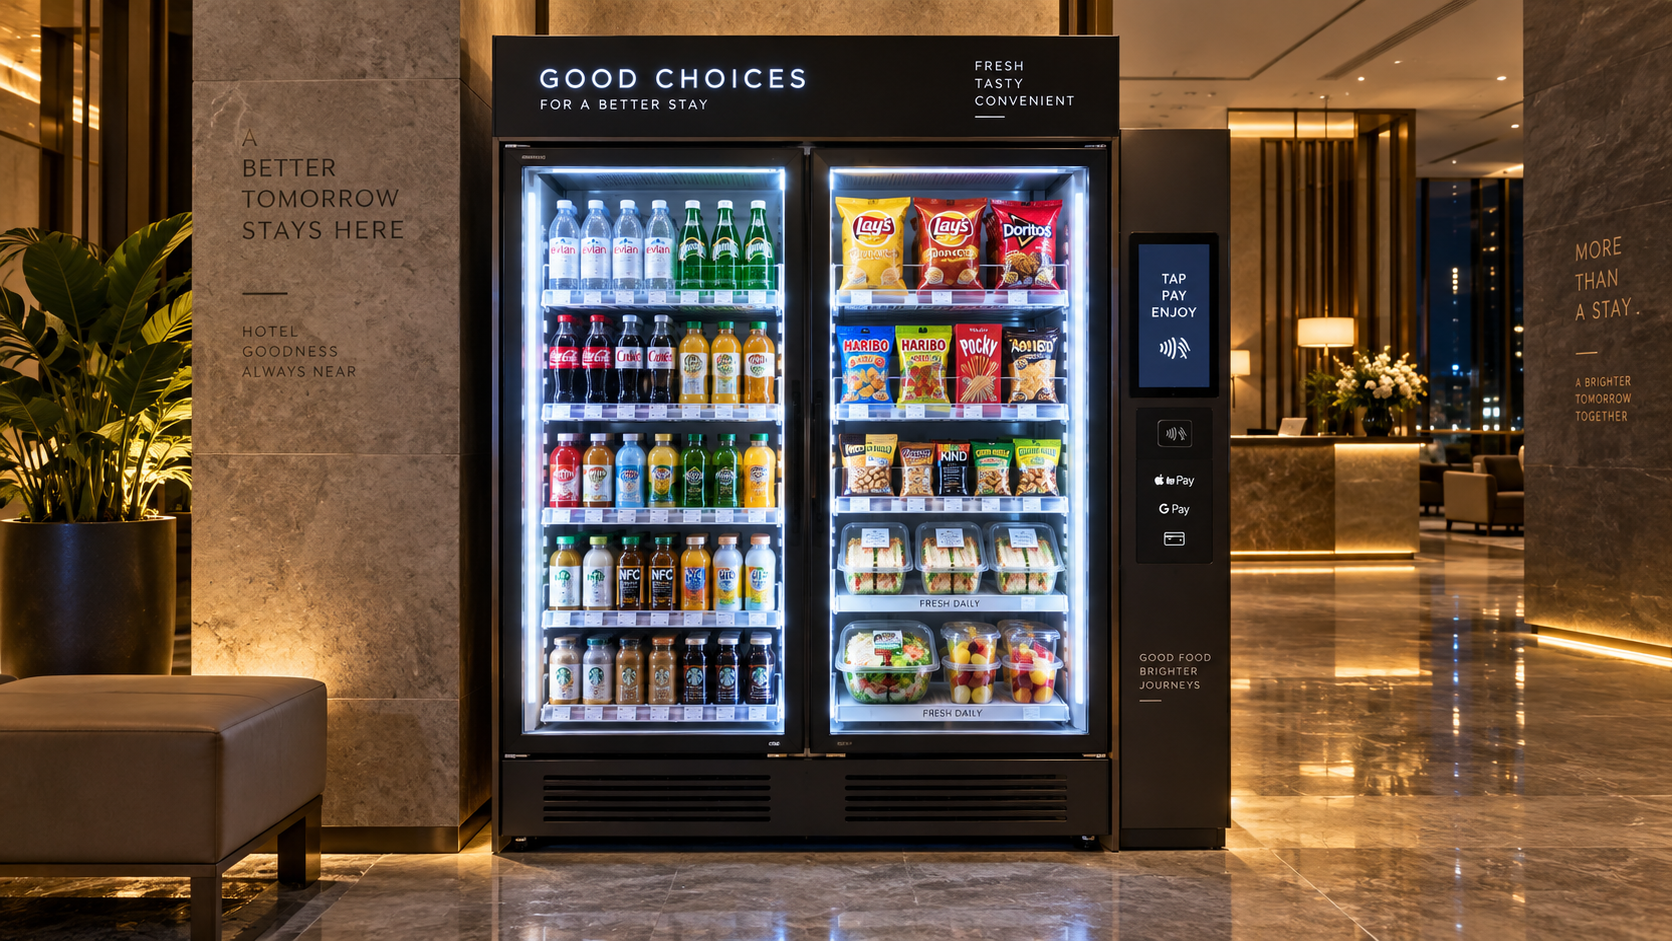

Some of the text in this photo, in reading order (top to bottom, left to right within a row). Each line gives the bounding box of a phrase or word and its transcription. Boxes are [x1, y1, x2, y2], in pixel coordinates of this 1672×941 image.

[975, 61, 1024, 71] FRESH
[540, 68, 806, 88] GOOD CHOICES
[975, 78, 1023, 89] TASTY
[541, 99, 708, 110] FOR A BETTER STAY
[975, 95, 1074, 106] CONVENIENT
[242, 129, 257, 146] A
[243, 158, 336, 177] BETTER
[242, 189, 399, 208] TOMORROW
[242, 220, 404, 240] STAYS HERE
[856, 216, 893, 236] Lay's
[933, 216, 971, 236] Lay's
[1003, 223, 1052, 238] Doritos
[1576, 236, 1622, 261] MORE
[1162, 274, 1187, 284] TAP
[1575, 268, 1618, 291] THAN
[1162, 291, 1187, 301] PAY
[1151, 307, 1197, 318] ENJOY
[1575, 303, 1586, 321] A
[242, 326, 299, 337] HOTEL
[843, 339, 889, 352] HARIBO
[901, 339, 946, 352] HARIBO
[243, 346, 338, 357] GOODNESS
[242, 366, 356, 377] ALWAYS NEAR
[1575, 375, 1631, 388] A BRIGHTER
[1575, 393, 1632, 404] TOMORROW
[1575, 411, 1628, 422] TOGETHER
[941, 451, 967, 462] KIND
[1176, 475, 1195, 487] Pay
[1172, 504, 1190, 516] Pay
[619, 569, 640, 581] NFC
[651, 569, 673, 581] NFC
[920, 599, 950, 608] FRESH
[1139, 653, 1211, 662] GOOD FOOD
[1140, 667, 1198, 676] BRIGHTER
[1139, 681, 1201, 690] JOURNEYS
[923, 709, 983, 718] FRESH DAILY
